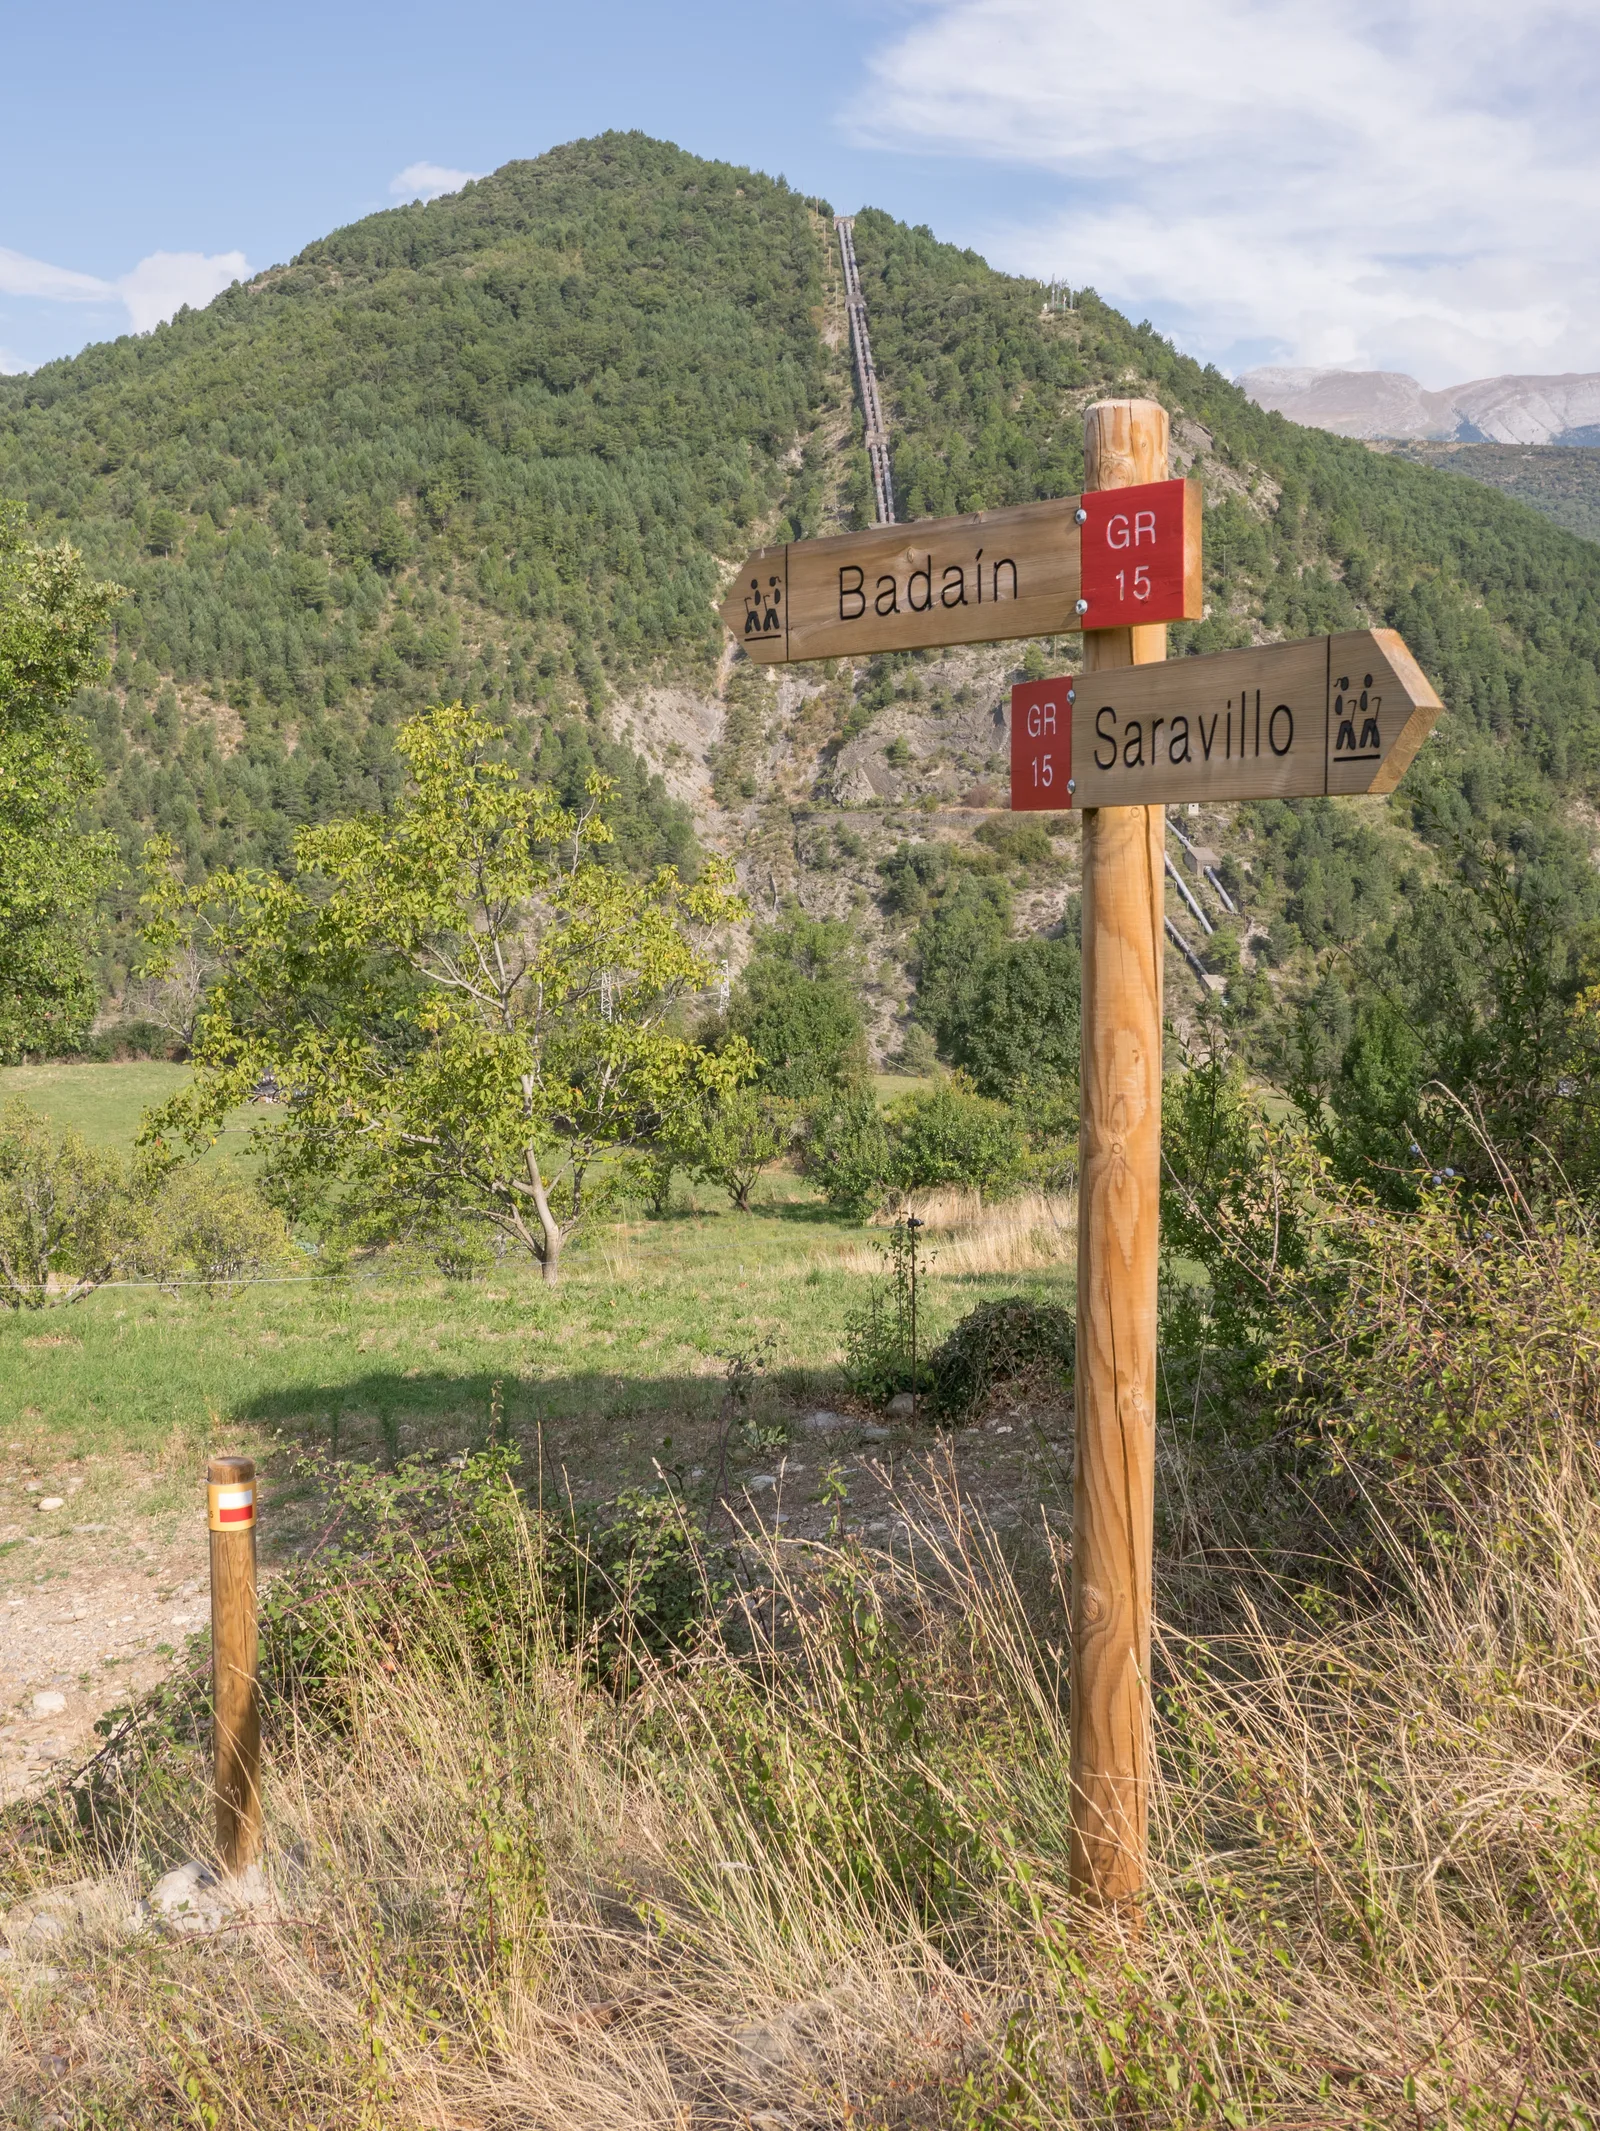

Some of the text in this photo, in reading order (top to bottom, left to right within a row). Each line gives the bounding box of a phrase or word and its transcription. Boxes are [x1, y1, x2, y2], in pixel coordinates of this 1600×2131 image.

[1106, 510, 1156, 549] GR
[839, 549, 1017, 621] Badaín
[1115, 566, 1151, 600] 15
[1027, 702, 1056, 738] GR
[1094, 689, 1294, 771] Saravillo
[1031, 754, 1053, 788] 15
